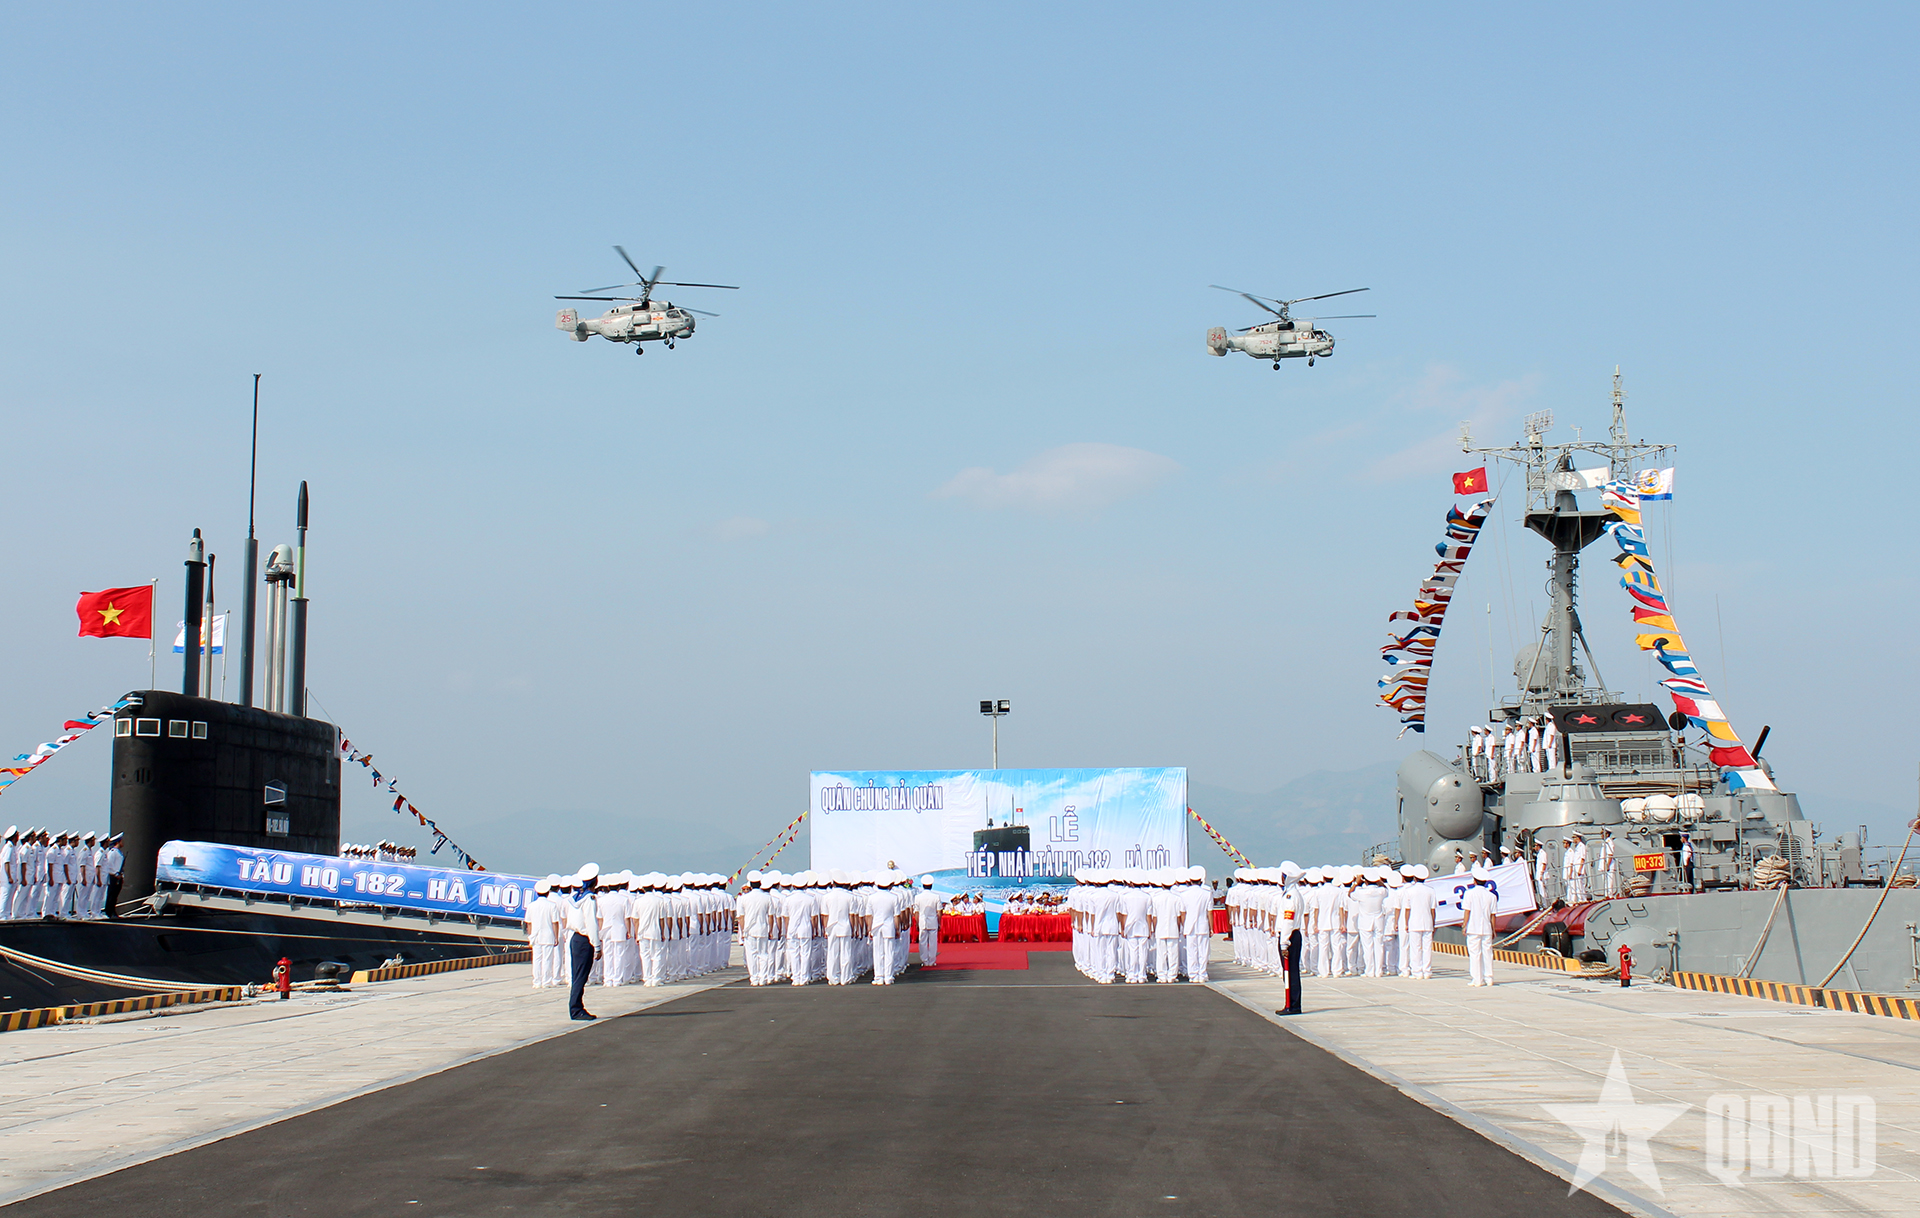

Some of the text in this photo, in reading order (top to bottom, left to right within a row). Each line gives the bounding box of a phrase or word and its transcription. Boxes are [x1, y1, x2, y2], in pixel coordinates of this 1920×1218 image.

[561, 314, 571, 323] 25
[1211, 333, 1222, 341] 24
[821, 778, 943, 814] QUÂN CHỦNG HẢI QUÂN
[1454, 803, 1461, 812] 2
[1049, 804, 1079, 842] LỄ
[965, 843, 995, 878] TIẾP
[998, 844, 1034, 883] NHẬN
[1037, 844, 1063, 877] TÀU
[1634, 856, 1664, 869] HQ-373
[237, 856, 294, 885] TÀU
[301, 864, 406, 897] HQ-182
[427, 876, 469, 904] HÀ
[479, 882, 535, 913] NỘI
